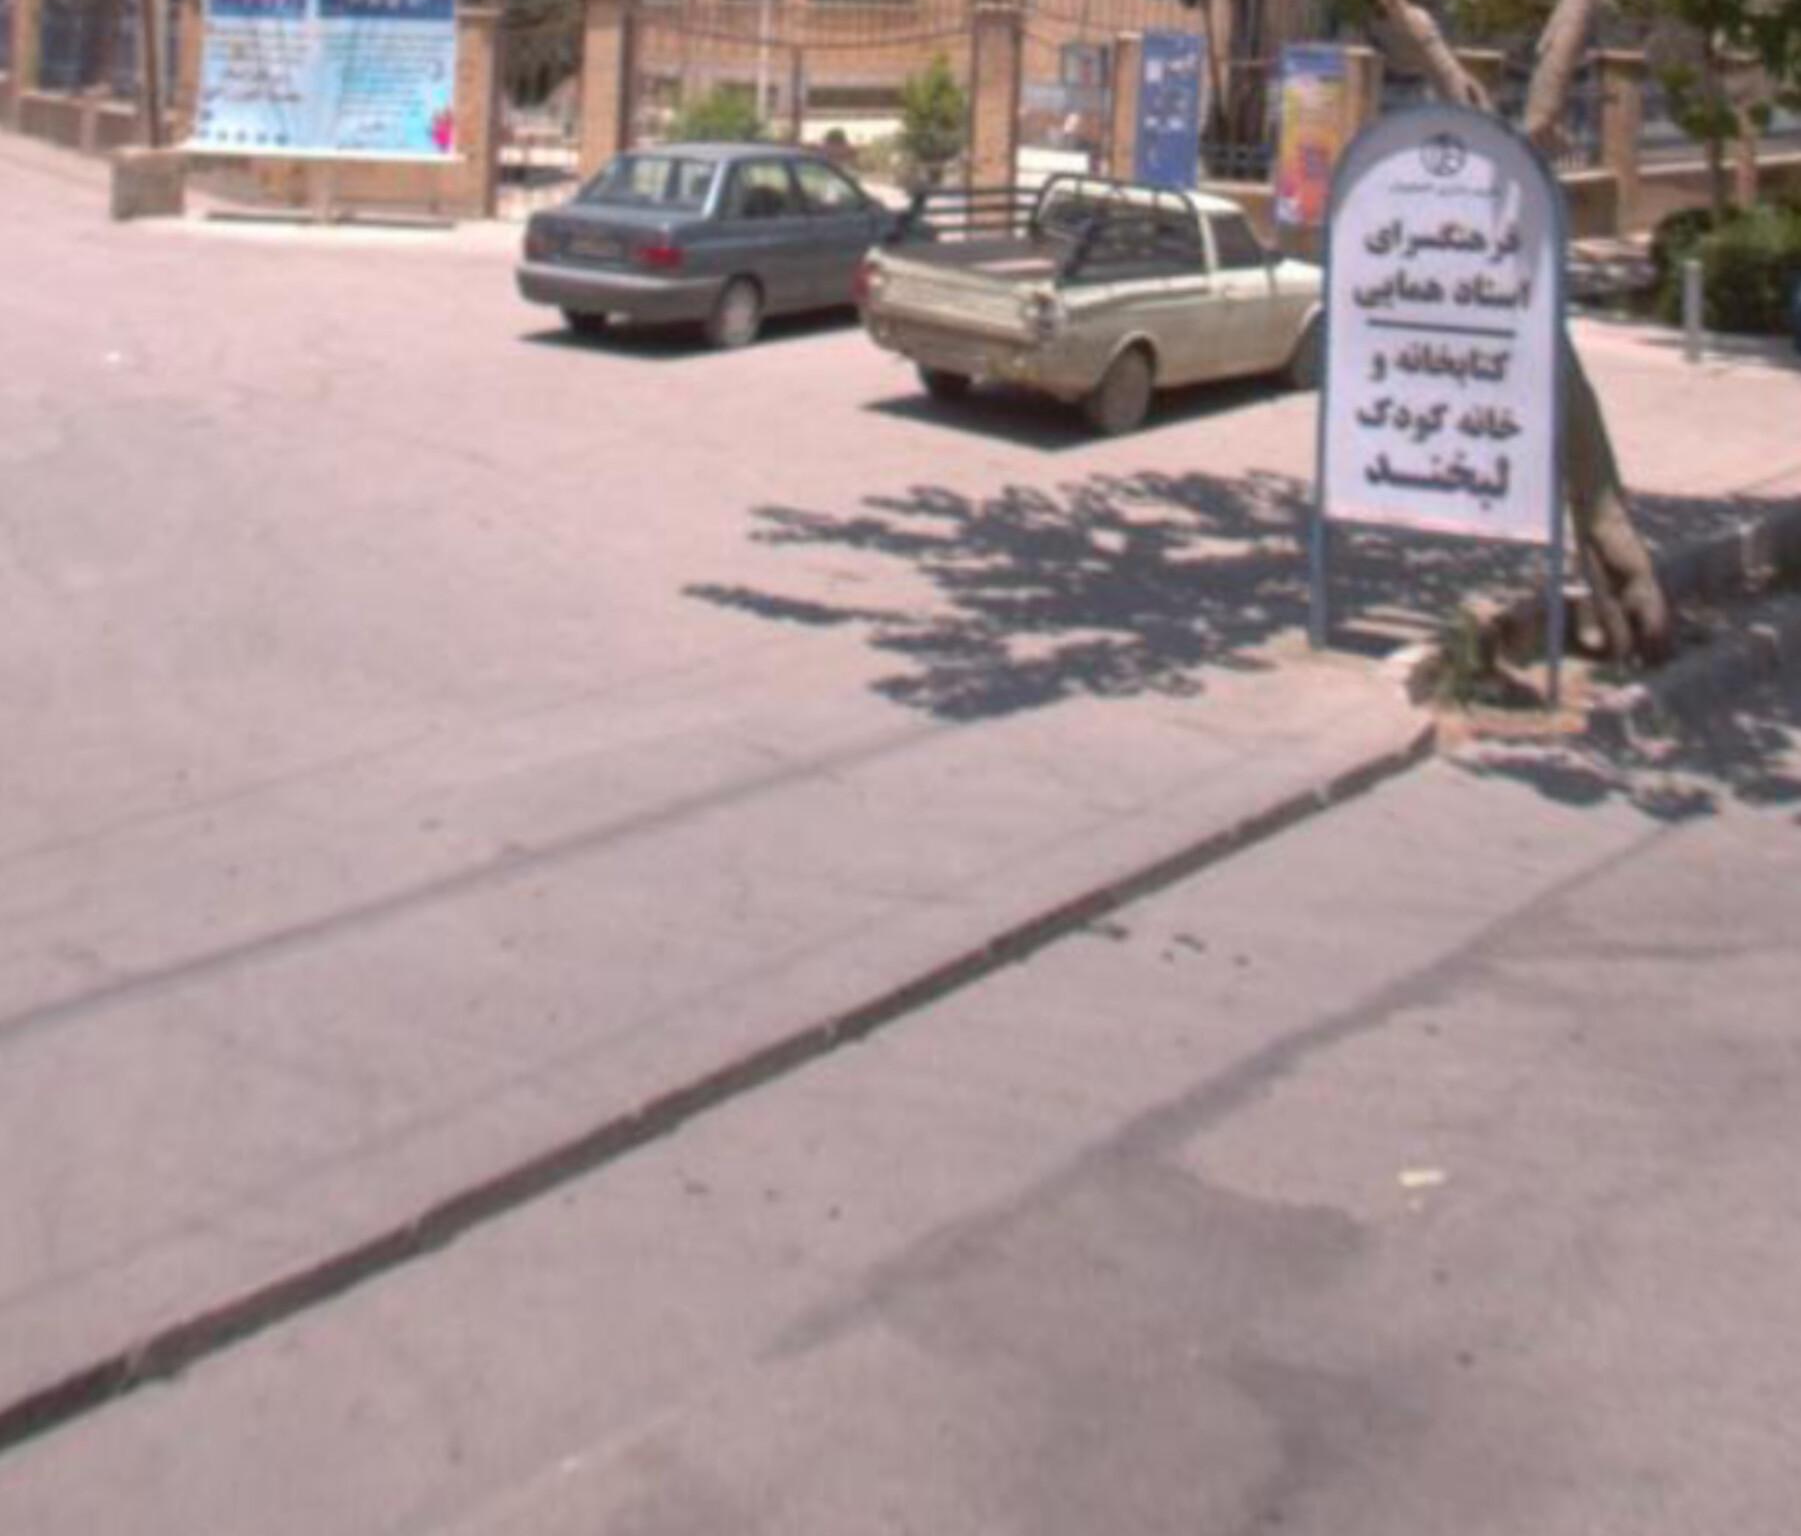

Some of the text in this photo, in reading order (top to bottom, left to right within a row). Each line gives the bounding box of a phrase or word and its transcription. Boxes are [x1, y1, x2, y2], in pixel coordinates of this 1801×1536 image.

[1364, 219, 1522, 264] فرهنگسرای
[1352, 268, 1531, 310] استاد همایی
[1369, 340, 1510, 386] کتابخانه و
[1356, 397, 1522, 444] خانه کودک
[1364, 449, 1511, 510] لبخند
